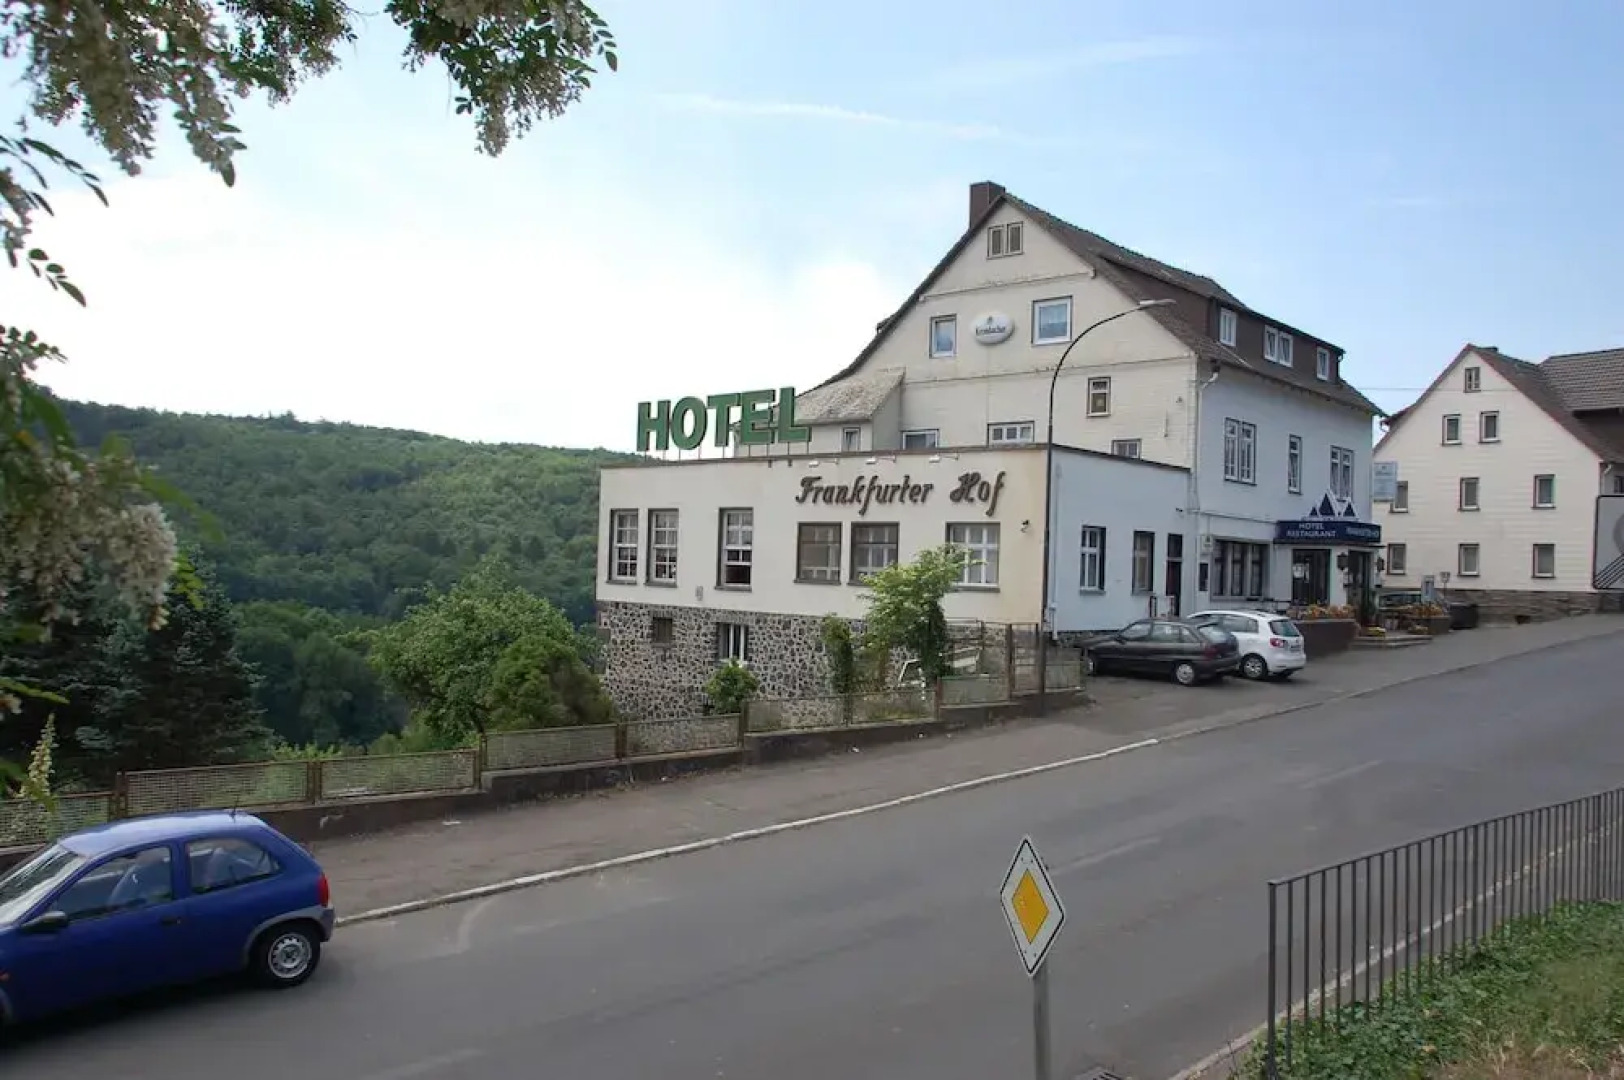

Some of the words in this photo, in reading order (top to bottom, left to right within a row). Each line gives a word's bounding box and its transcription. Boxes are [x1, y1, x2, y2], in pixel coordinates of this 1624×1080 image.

[637, 387, 812, 451] HOTEL
[795, 474, 934, 516] Frankfurter
[949, 471, 1006, 517] Hof
[1298, 522, 1325, 530] HOTEL
